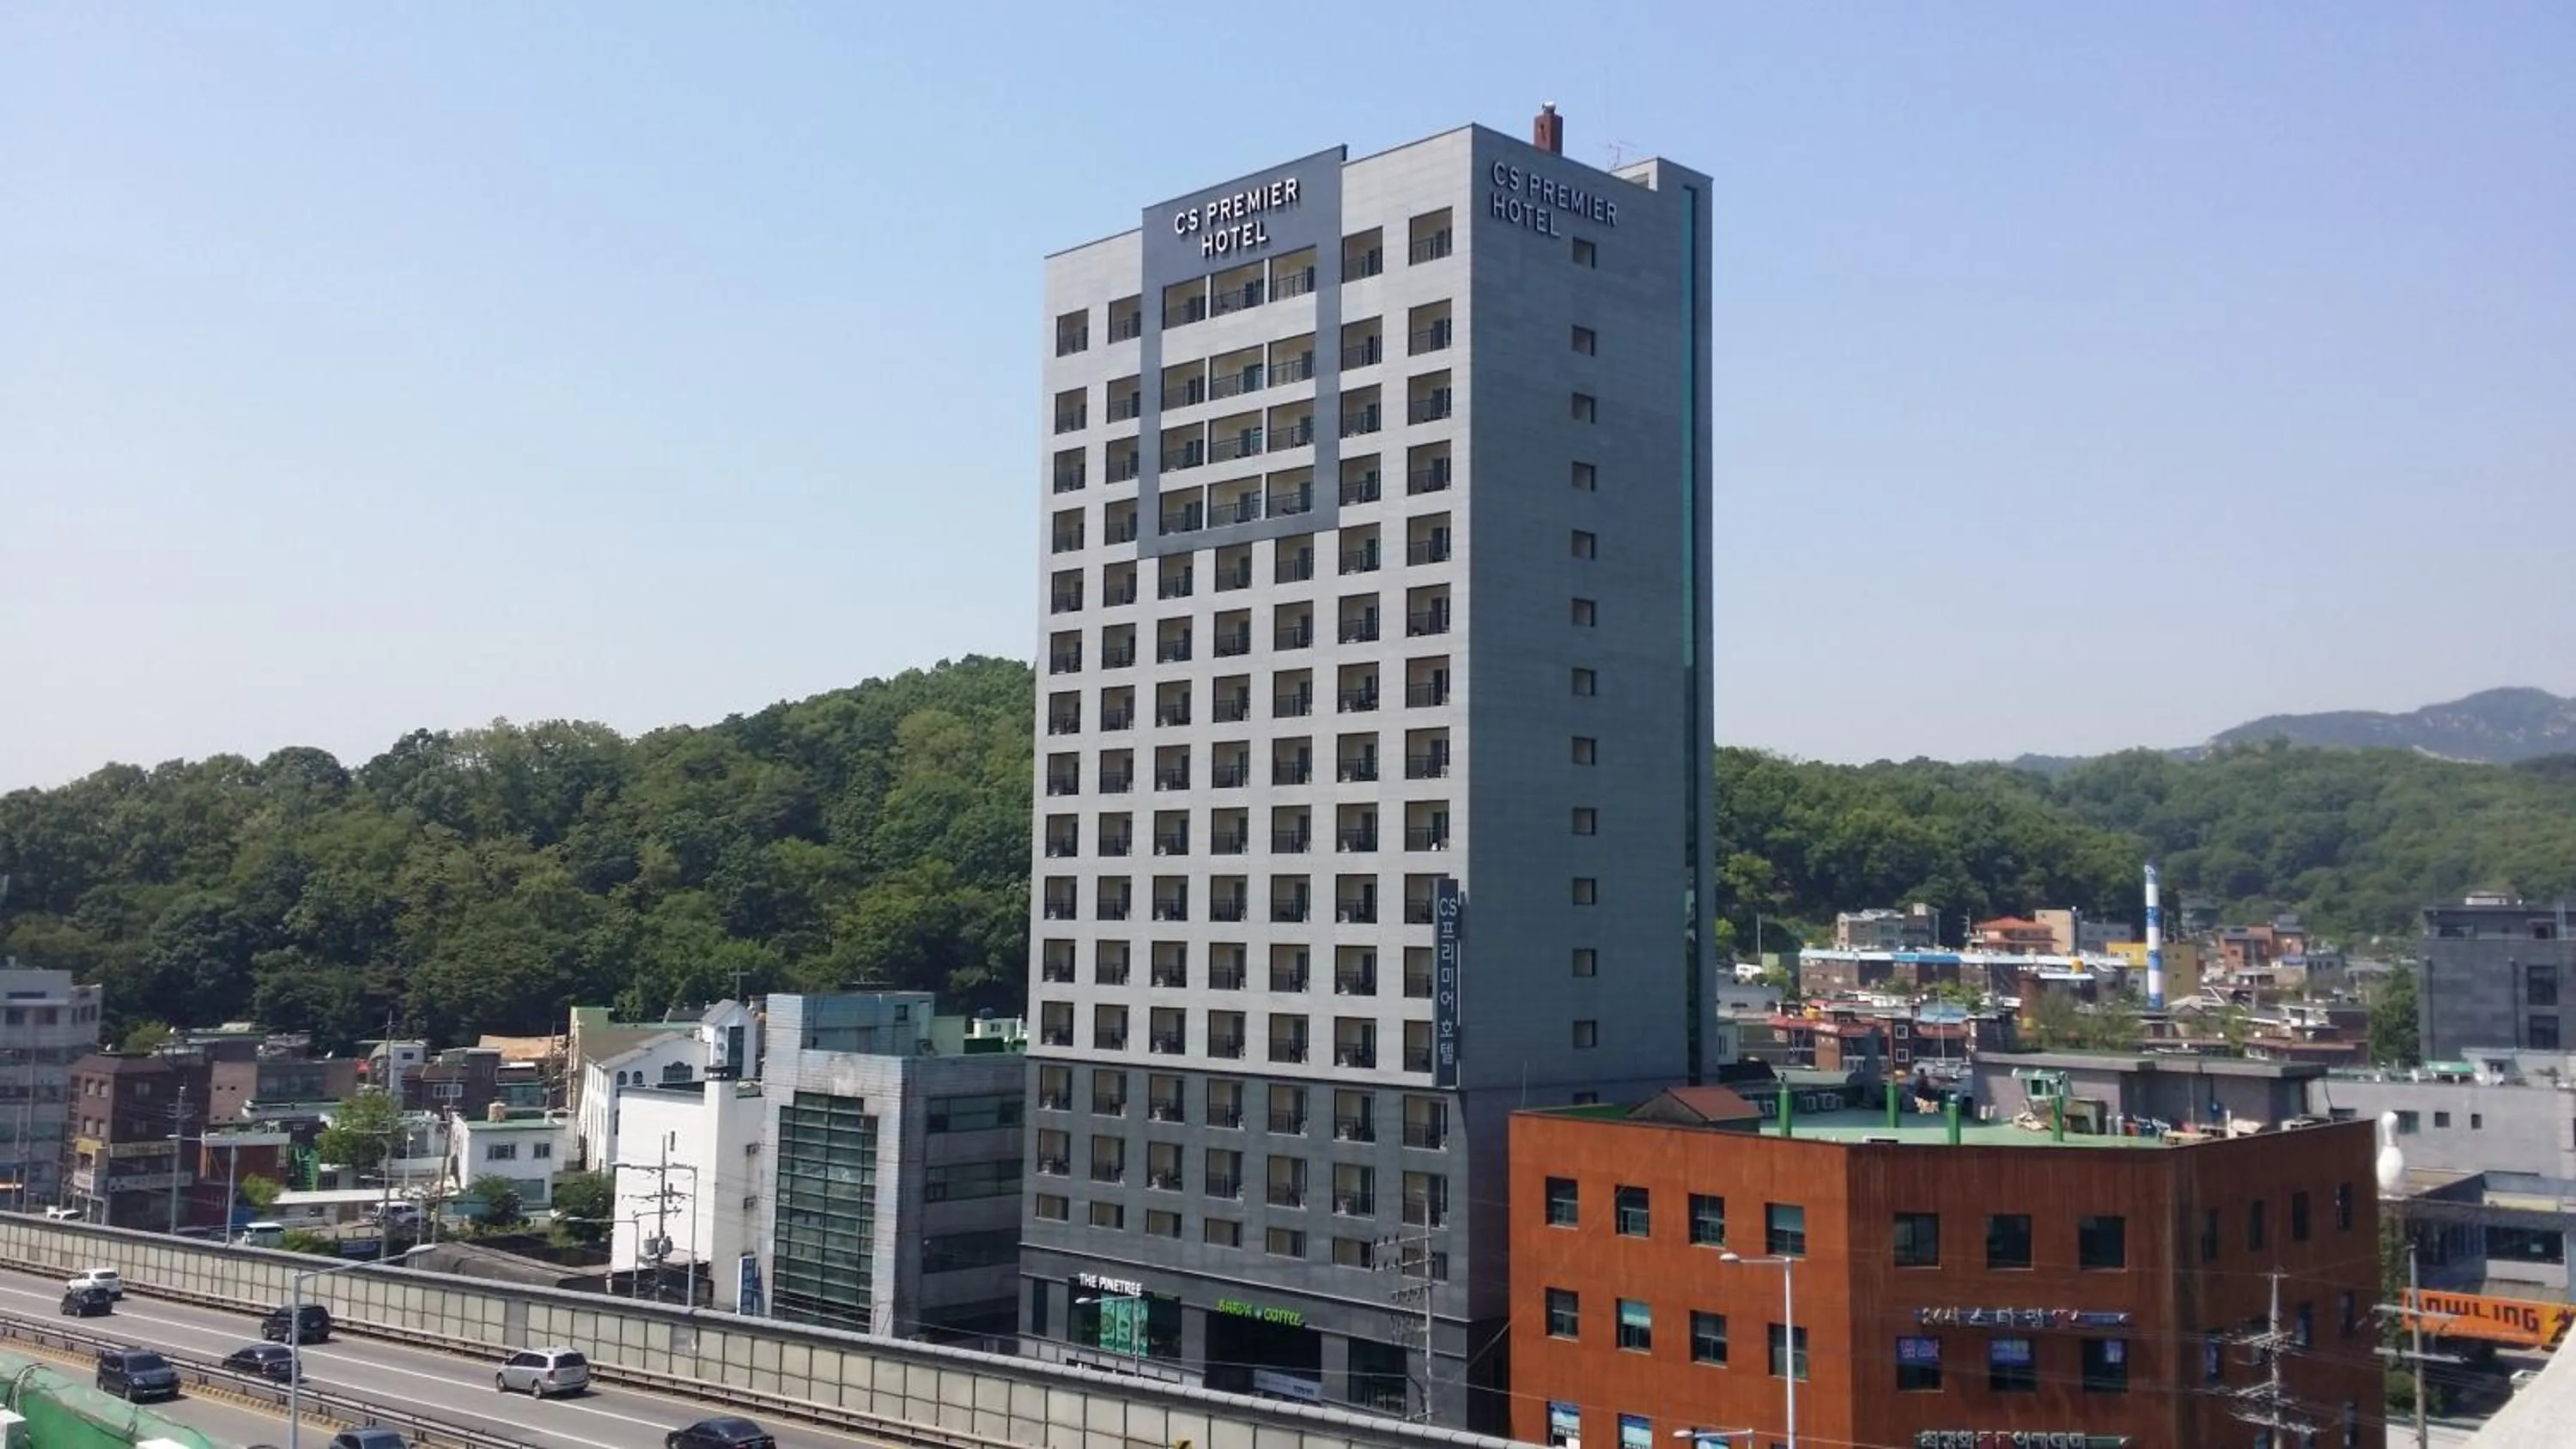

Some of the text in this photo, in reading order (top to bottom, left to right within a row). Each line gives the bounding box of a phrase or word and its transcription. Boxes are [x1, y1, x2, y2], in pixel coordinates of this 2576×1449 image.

[1174, 178, 1297, 234] CS PREMIER
[1492, 191, 1561, 237] HOTEL
[1493, 161, 1618, 226] CS PREMIER
[1201, 220, 1267, 257] HOTEL
[1438, 897, 1457, 917] CS
[1440, 921, 1455, 1014] 프리미어
[1078, 1273, 1143, 1297] THE PINETREE
